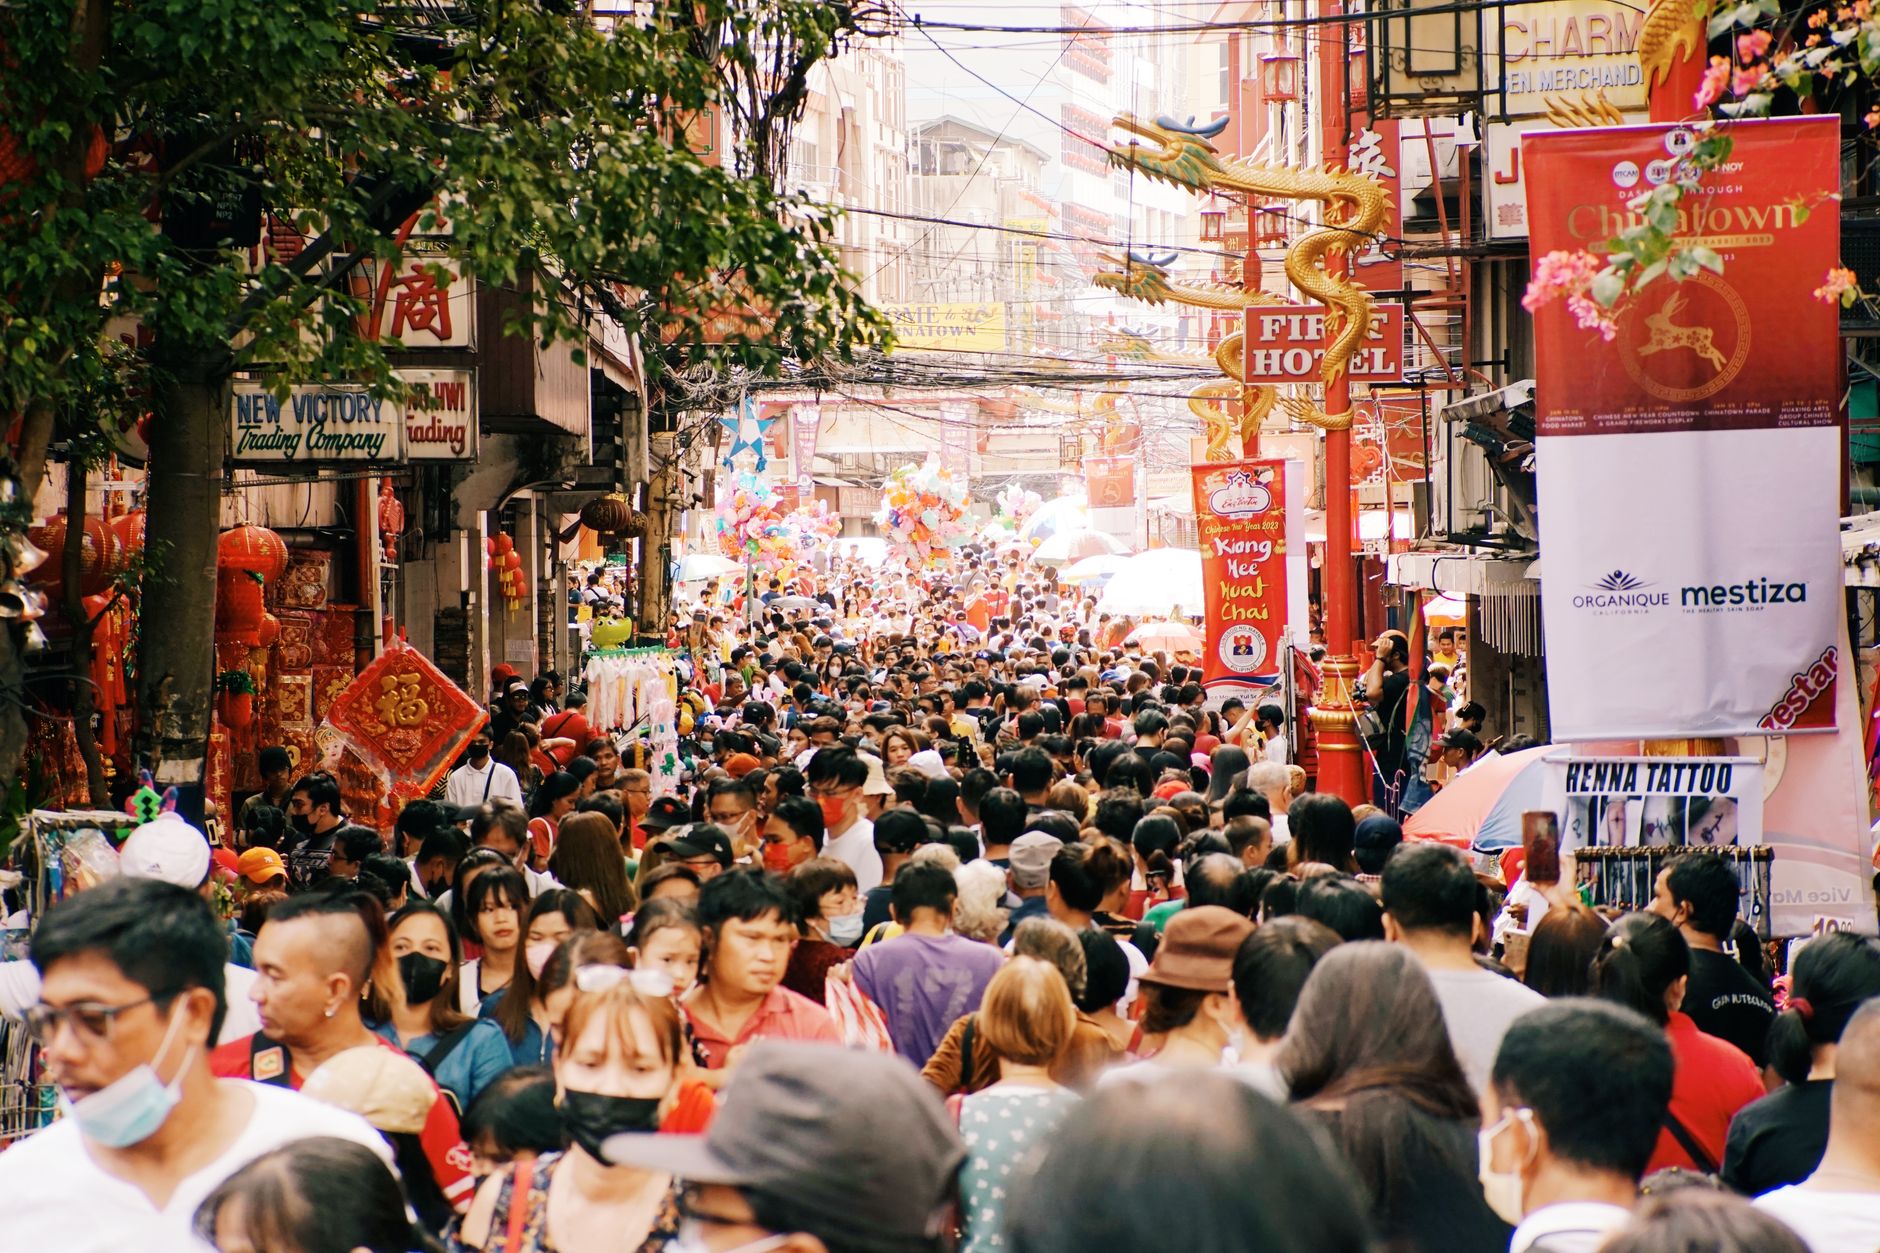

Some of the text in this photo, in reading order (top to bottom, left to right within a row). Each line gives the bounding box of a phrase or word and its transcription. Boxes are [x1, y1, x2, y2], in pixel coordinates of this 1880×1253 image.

[238, 393, 281, 423] NEW
[292, 392, 382, 423] VICTORY
[237, 422, 386, 460] Trading Company
[1205, 521, 1279, 534] Chinese New Year 2023
[1573, 577, 1807, 609] ORGANIQUE mestiza
[1221, 602, 1269, 621] Chai
[1567, 763, 1733, 793] HENNA TATTOO
